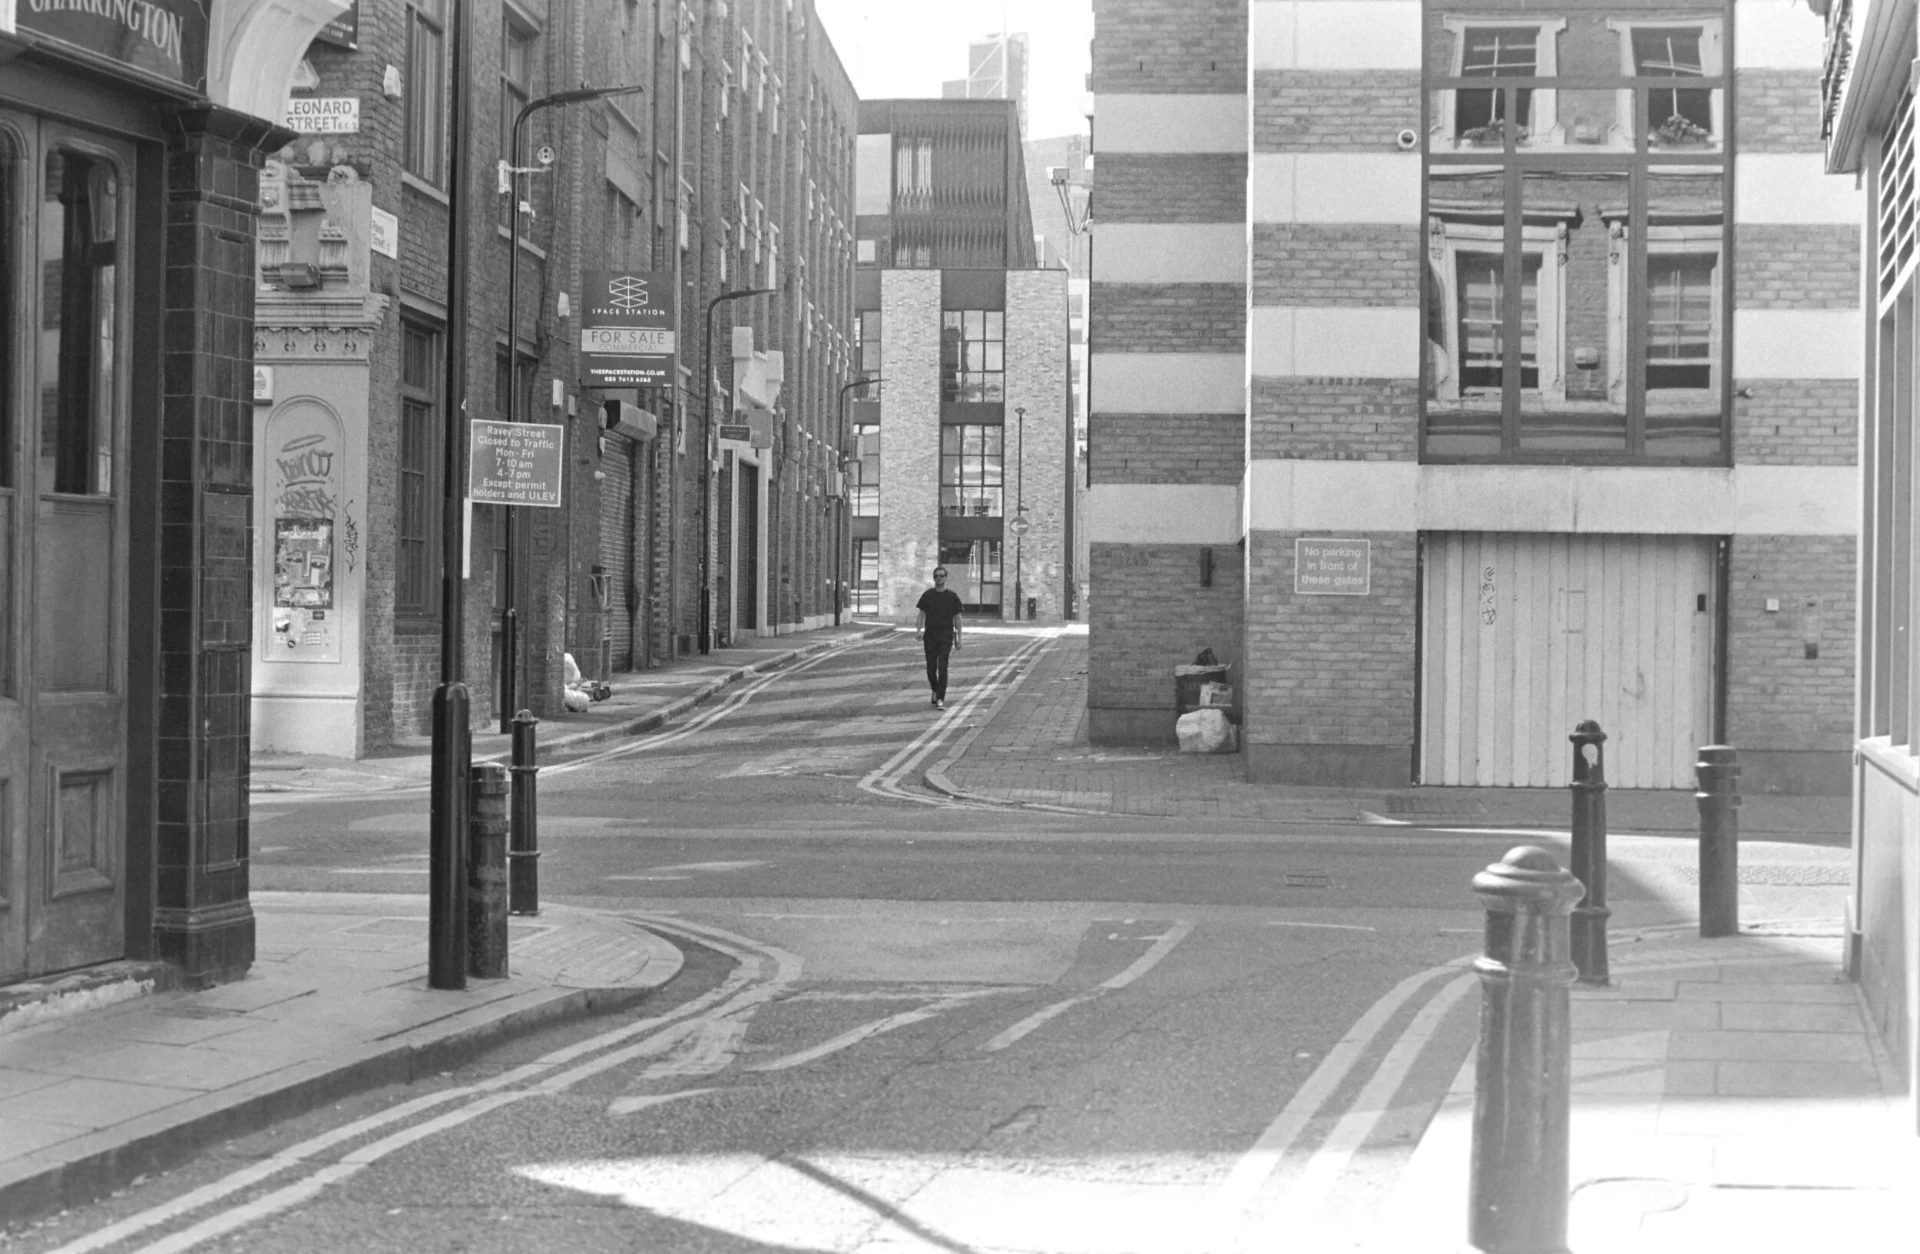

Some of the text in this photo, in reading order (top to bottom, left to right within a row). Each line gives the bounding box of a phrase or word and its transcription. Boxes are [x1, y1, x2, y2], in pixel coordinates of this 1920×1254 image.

[29, 0, 183, 65] INGTON
[287, 116, 339, 130] STREET
[591, 331, 665, 344] FOR SALE
[598, 344, 657, 352] COMMERCIAL
[487, 425, 546, 438] Ravey Street
[478, 436, 554, 449] Closed to Traffic
[496, 448, 514, 457] Mon
[522, 449, 534, 458] Fri
[483, 478, 546, 490] Except permit
[473, 488, 556, 500] holders and ULEV
[1305, 547, 1362, 558] No parking
[1320, 559, 1344, 570] front
[1347, 561, 1358, 570] of
[1334, 576, 1364, 587] gates
